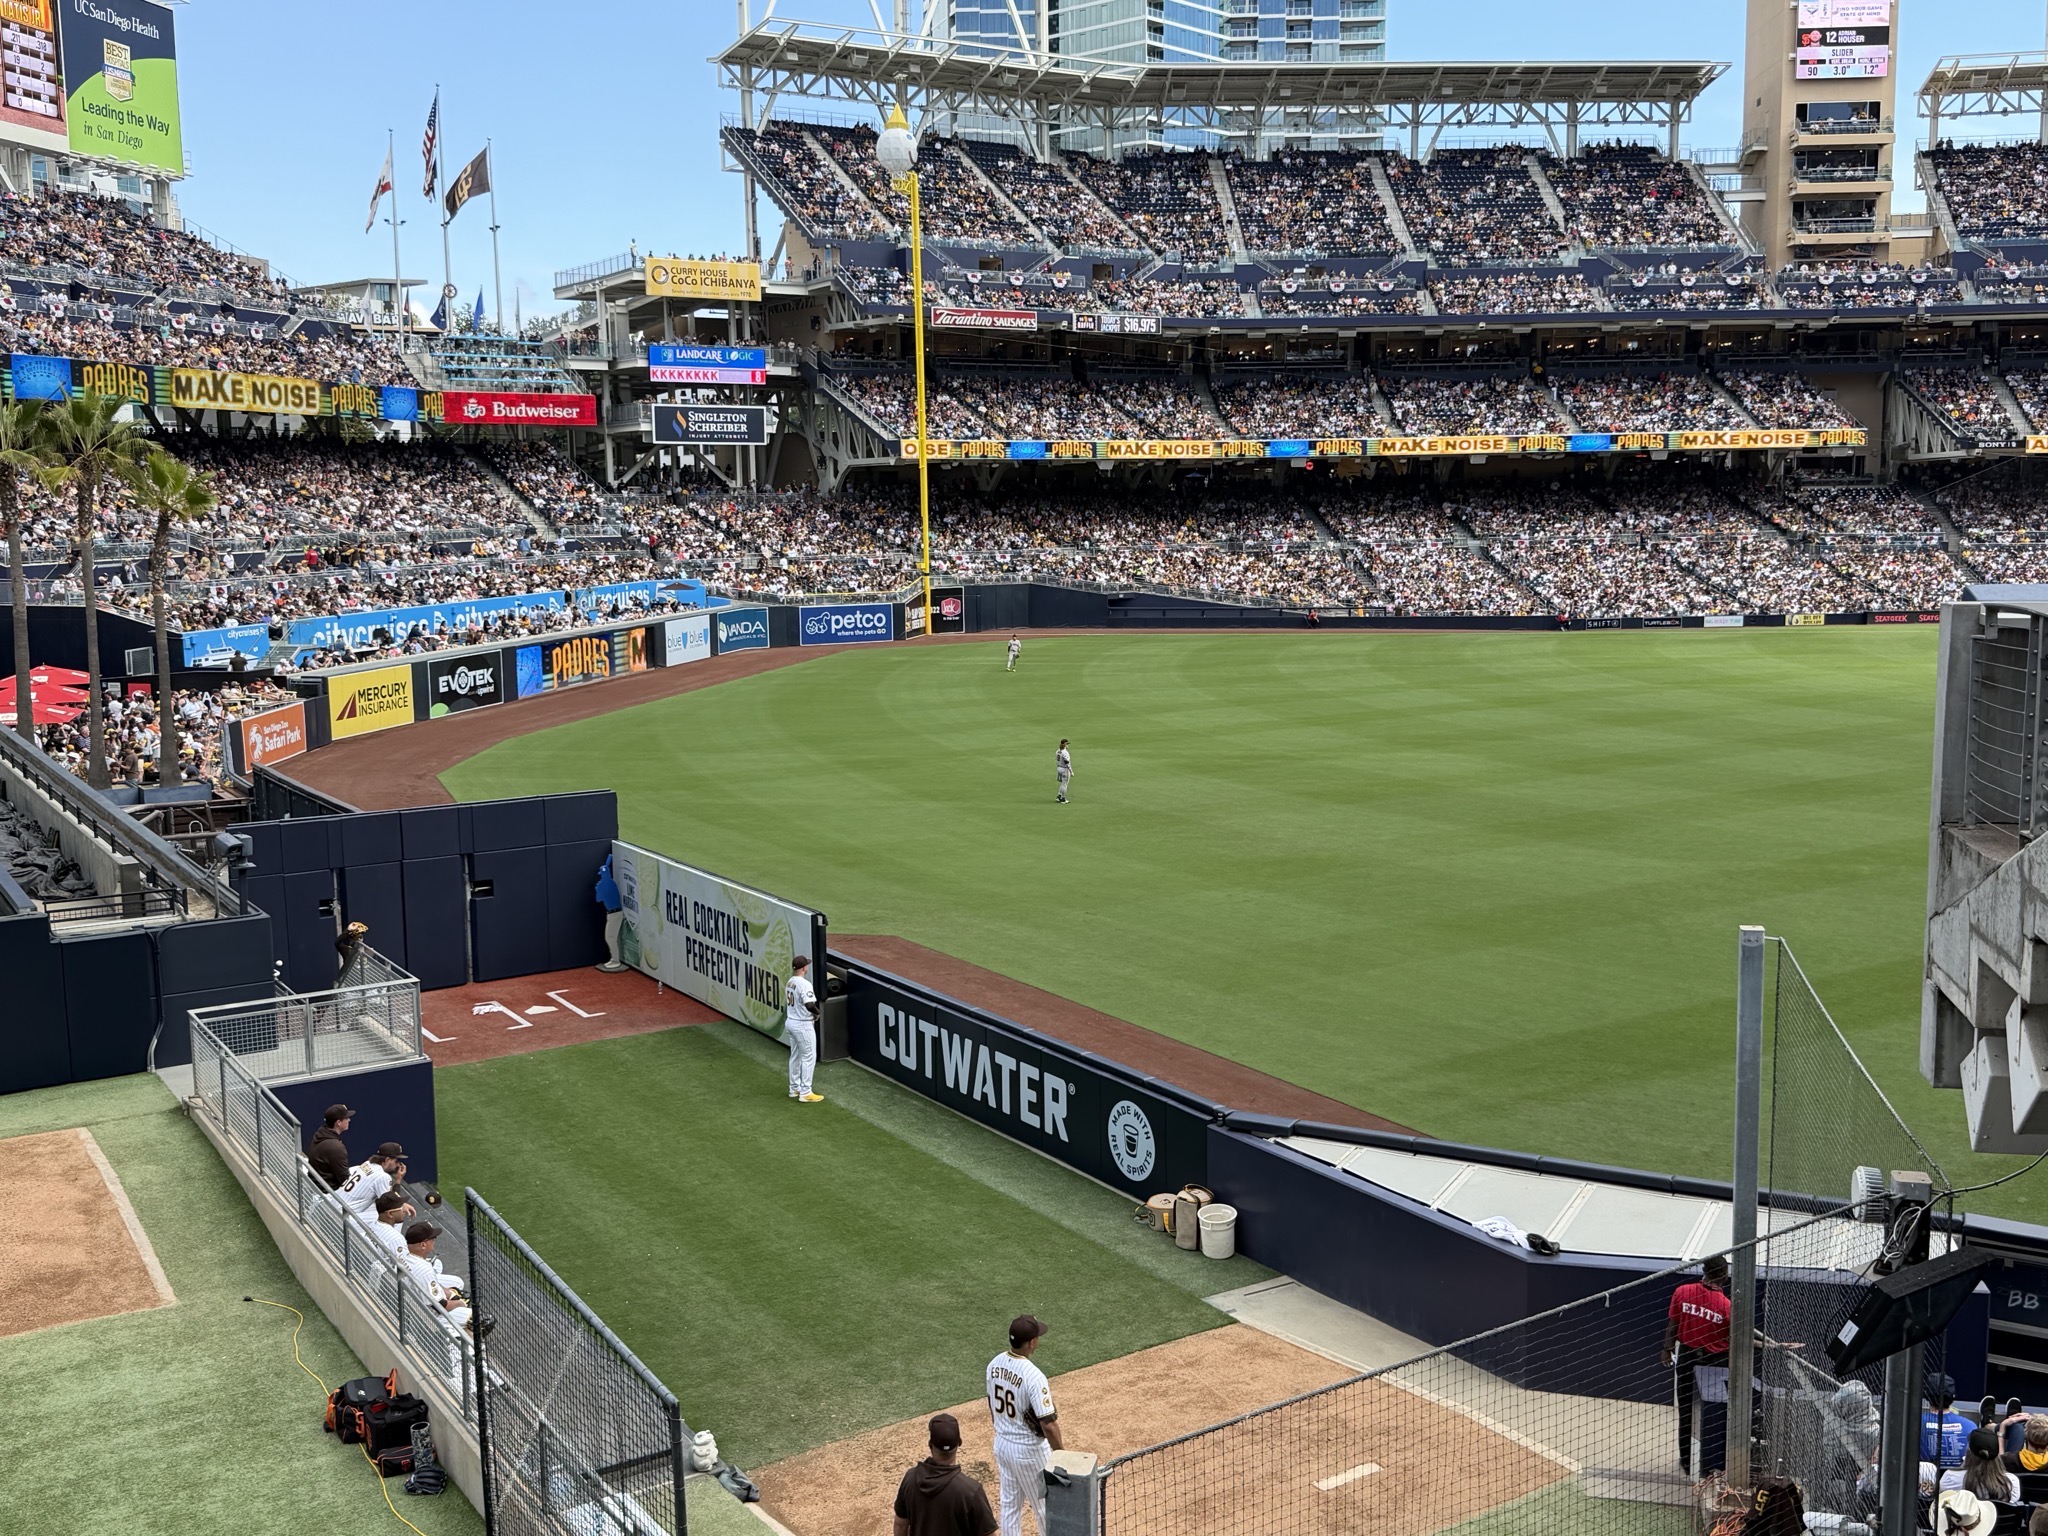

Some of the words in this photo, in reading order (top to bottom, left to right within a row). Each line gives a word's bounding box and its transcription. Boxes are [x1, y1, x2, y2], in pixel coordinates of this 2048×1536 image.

[31, 8, 45, 28] JR.
[74, 0, 89, 16] UC
[89, 2, 106, 22] San
[107, 8, 131, 31] Diego
[131, 17, 160, 39] Health
[1826, 31, 1837, 43] 12
[1838, 35, 1865, 43] HOUSER
[105, 42, 128, 60] BEST
[1831, 49, 1854, 57] SLIDER
[40, 62, 45, 71] 2
[105, 56, 130, 70] HOSPITALS
[1807, 66, 1818, 76] 90
[1833, 65, 1851, 76] 3.0"
[1864, 64, 1879, 75] 1.2"
[81, 96, 125, 125] Leading
[126, 110, 144, 127] the
[146, 114, 170, 136] Way
[83, 121, 93, 136] in
[96, 125, 114, 141] San
[117, 130, 143, 150] Diego
[670, 266, 698, 276] CURRY
[699, 268, 728, 278] HOUSE
[670, 275, 698, 286] CoCo
[700, 276, 756, 289] ICHIBANYA
[935, 309, 993, 328] Tarantino
[993, 316, 1036, 328] SAUSAGES
[1101, 316, 1121, 324] TODAY'S
[1124, 317, 1156, 333] $16,975
[1101, 324, 1121, 332] JACKPOT
[676, 348, 723, 361] LANDCARE
[755, 371, 761, 382] 8
[82, 363, 149, 403] PADRES
[174, 372, 244, 402] MAKE
[251, 380, 319, 409] NOISE
[331, 384, 378, 417] PADRES
[492, 401, 580, 419] Budweiser
[688, 411, 747, 422] SINGLETON
[688, 422, 748, 432] SCHREIBER
[904, 443, 949, 456] OSE
[961, 442, 1005, 459] PADRES
[1052, 441, 1093, 458] PADRES
[1109, 441, 1158, 455] MAKE
[1162, 443, 1211, 456] NOISE
[1221, 440, 1264, 457] PADRES
[1316, 439, 1363, 456] PADRES
[1382, 437, 1438, 453] MAKE
[1449, 438, 1504, 451] NOISE
[1517, 435, 1565, 452] PADRES
[1617, 433, 1664, 450] PADRES
[1683, 431, 1740, 447] MAKE
[1749, 432, 1805, 445] NOISE
[1819, 430, 1865, 446] PADRES
[942, 600, 956, 615] Jack
[831, 610, 886, 634] petco
[1875, 614, 1907, 622] SEATGEEK
[689, 631, 703, 644] blue
[727, 620, 766, 637] VANDA
[864, 629, 876, 637] pets
[667, 635, 682, 648] blue
[552, 637, 610, 690] PADRES
[438, 666, 495, 694] EVOTEK
[358, 681, 407, 703] MERCURY
[358, 696, 409, 717] INSURANCE
[263, 726, 271, 735] San
[270, 723, 281, 732] Diego
[280, 720, 289, 729] Zoo
[264, 730, 286, 752] Safari
[286, 726, 302, 745] Park
[665, 889, 690, 930] REAL
[693, 899, 753, 958] COCKTAILS.
[685, 935, 740, 992] PERFECTLY
[745, 961, 784, 1013] MIXED.
[1111, 1105, 1131, 1127] MADE
[1133, 1108, 1151, 1140] WITH
[1110, 1134, 1124, 1168] REAL
[1126, 1149, 1153, 1176] SPIRITS
[1682, 1302, 1723, 1325] ELITE
[991, 1366, 1024, 1389] ESTRADA
[994, 1384, 1016, 1419] 56
